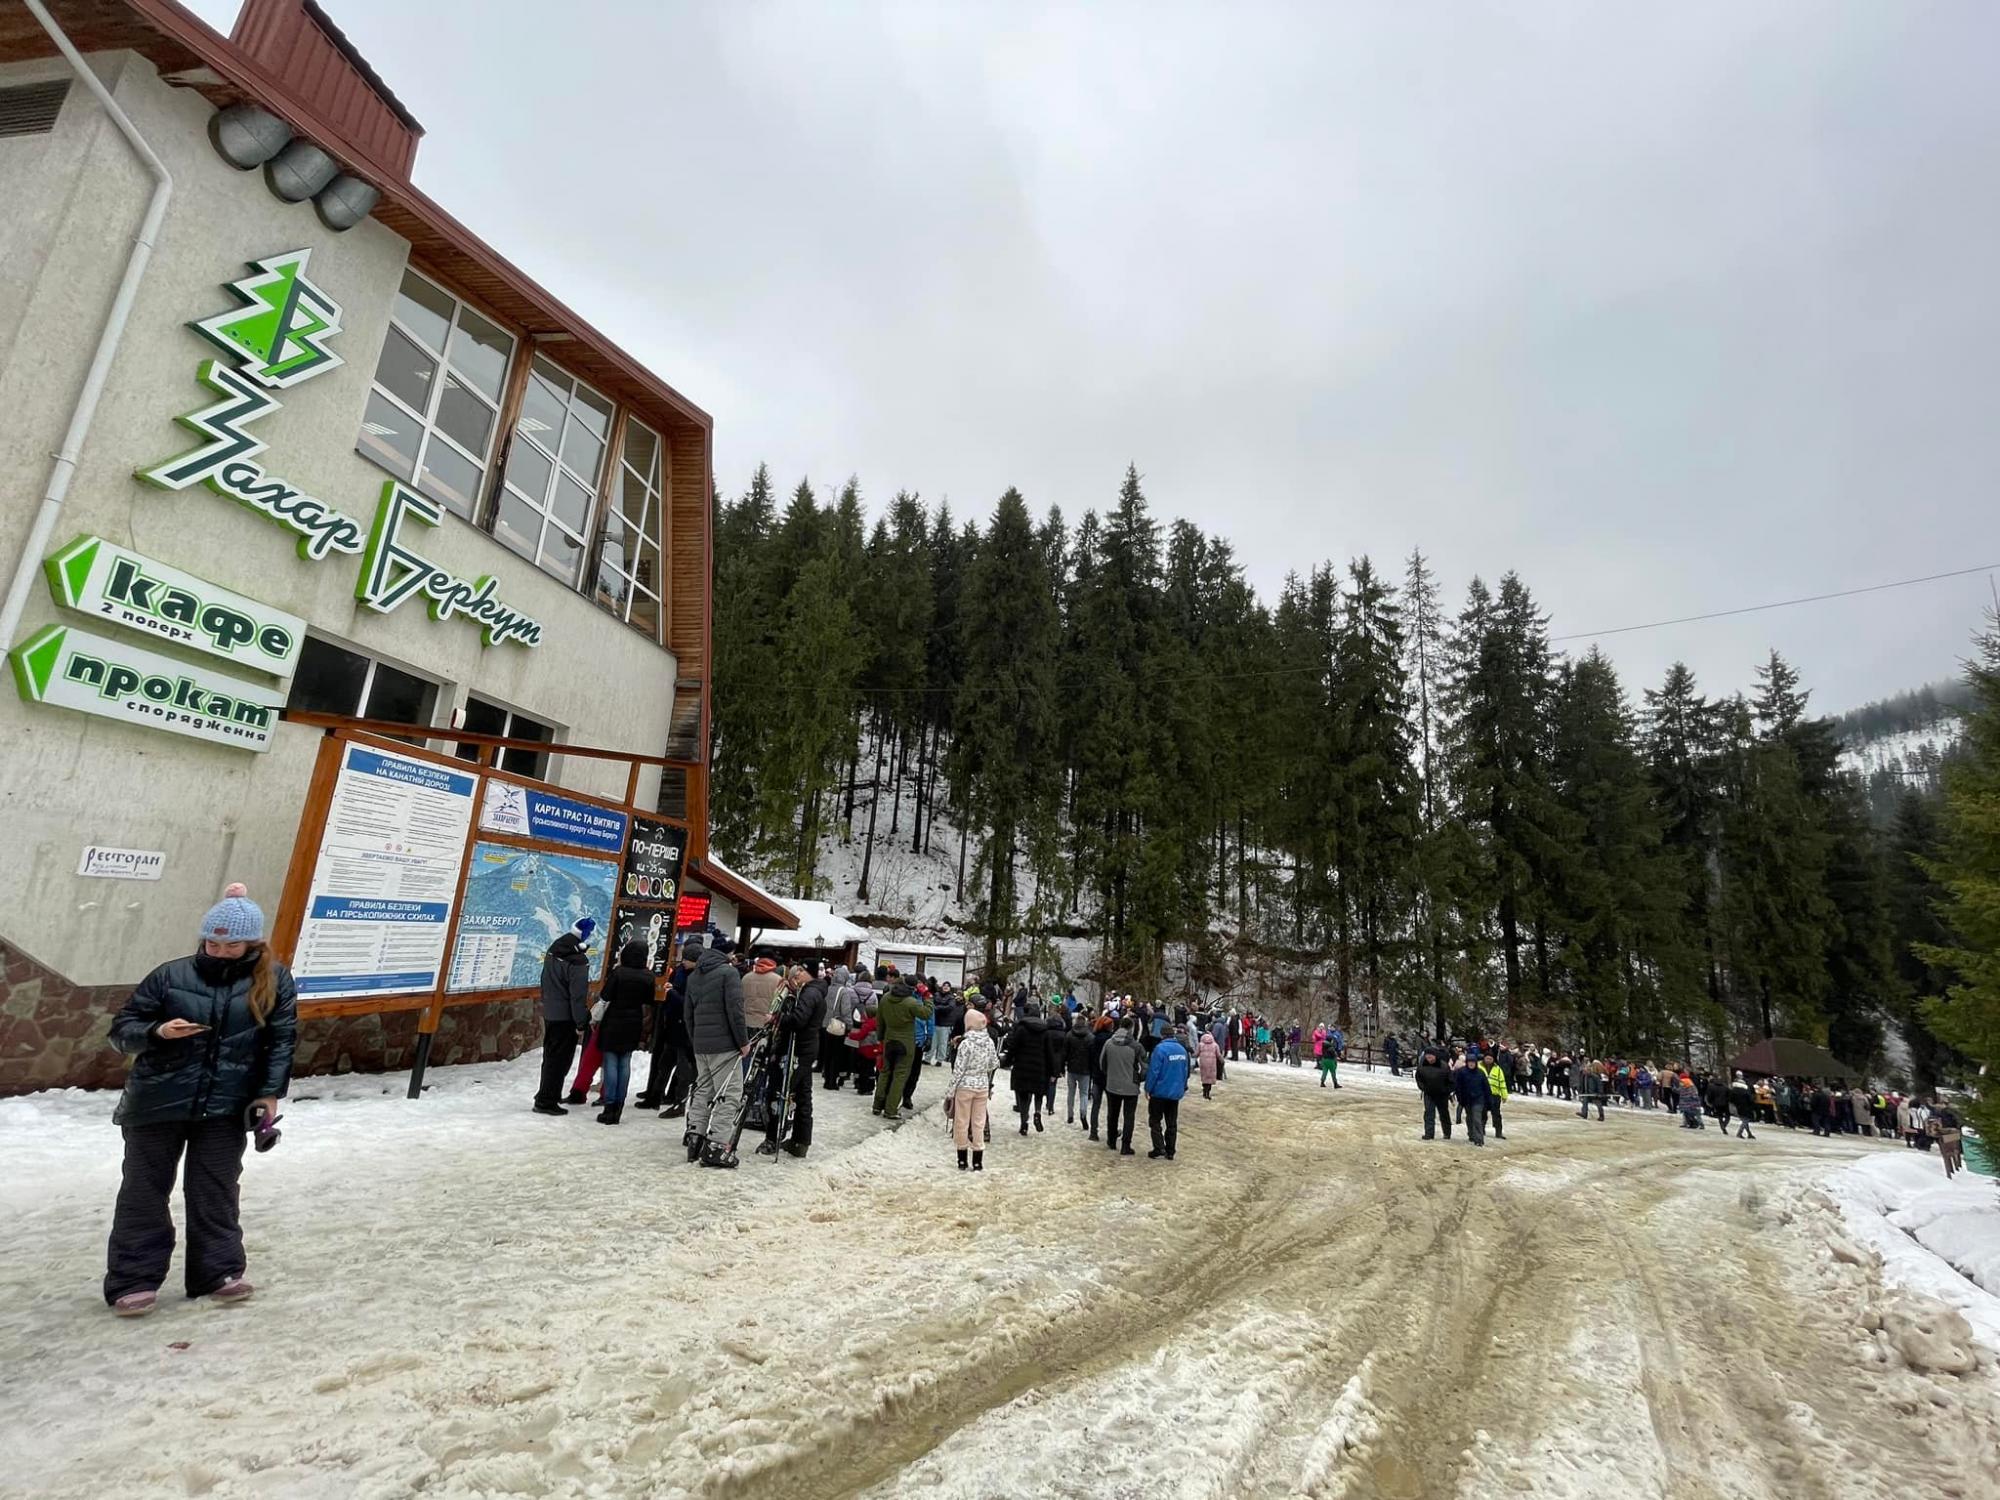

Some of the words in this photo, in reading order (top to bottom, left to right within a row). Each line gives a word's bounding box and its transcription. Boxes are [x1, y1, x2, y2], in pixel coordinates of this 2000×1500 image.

[155, 366, 364, 558] Захар
[368, 485, 542, 647] Беркут
[101, 603, 112, 613] 2
[122, 609, 193, 640] поверх
[106, 557, 291, 658] кафе
[66, 653, 271, 729] прокат
[127, 702, 266, 742] спорядження
[376, 767, 388, 777] НА
[388, 771, 425, 785] КАНАТНІЙ
[381, 759, 417, 774] ПРАВИЛА
[418, 769, 450, 782] БЕЗПЕКИ
[534, 803, 561, 817] КАРТА
[562, 809, 583, 821] ТРАС
[583, 814, 593, 824] ТА
[593, 817, 621, 831] ВИТЯГІВ
[326, 909, 338, 918] НА
[407, 913, 436, 921] СХИЛАХ
[349, 900, 386, 910] ПРАВИЛА
[387, 903, 421, 912] БЕЗПЕКИ
[463, 915, 491, 925] ЗАХАР
[492, 916, 522, 926] БЕРКУТ
